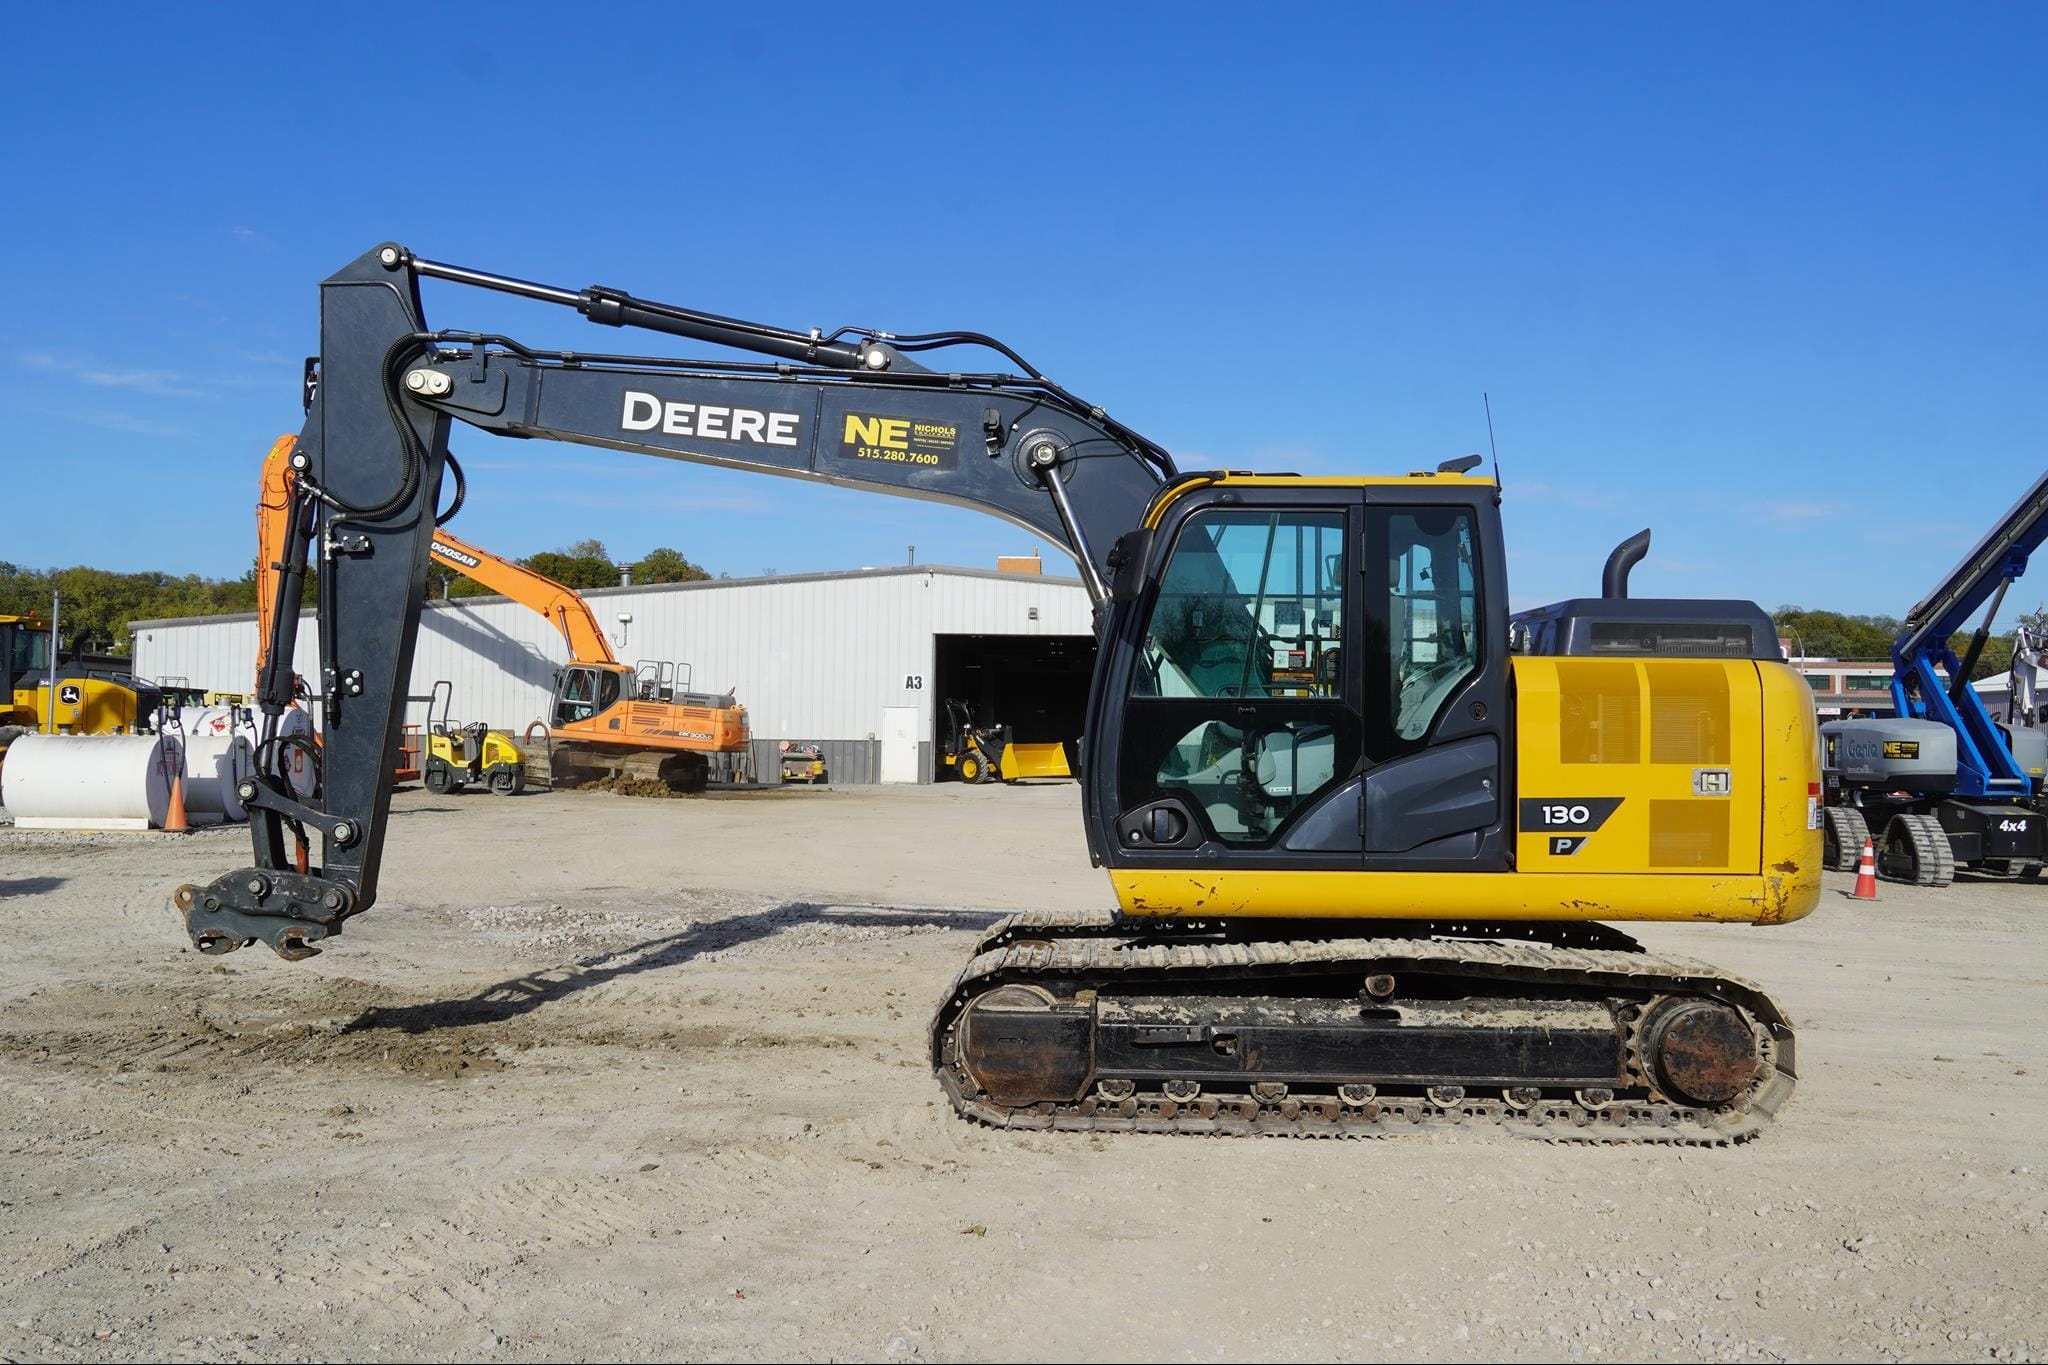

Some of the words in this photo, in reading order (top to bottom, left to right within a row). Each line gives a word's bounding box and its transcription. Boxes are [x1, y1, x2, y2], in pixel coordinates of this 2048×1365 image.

[622, 391, 800, 446] DEERE
[844, 415, 911, 449] NE
[914, 424, 956, 435] NICHOLS
[857, 447, 939, 465] 515.280.7600
[431, 541, 477, 566] DOOSAN
[905, 675, 922, 690] A3
[1847, 740, 1878, 759] Genie
[1883, 742, 1901, 754] NE
[1542, 805, 1590, 824] 130
[1999, 819, 2027, 832] 4x4
[1555, 838, 1572, 854] P
